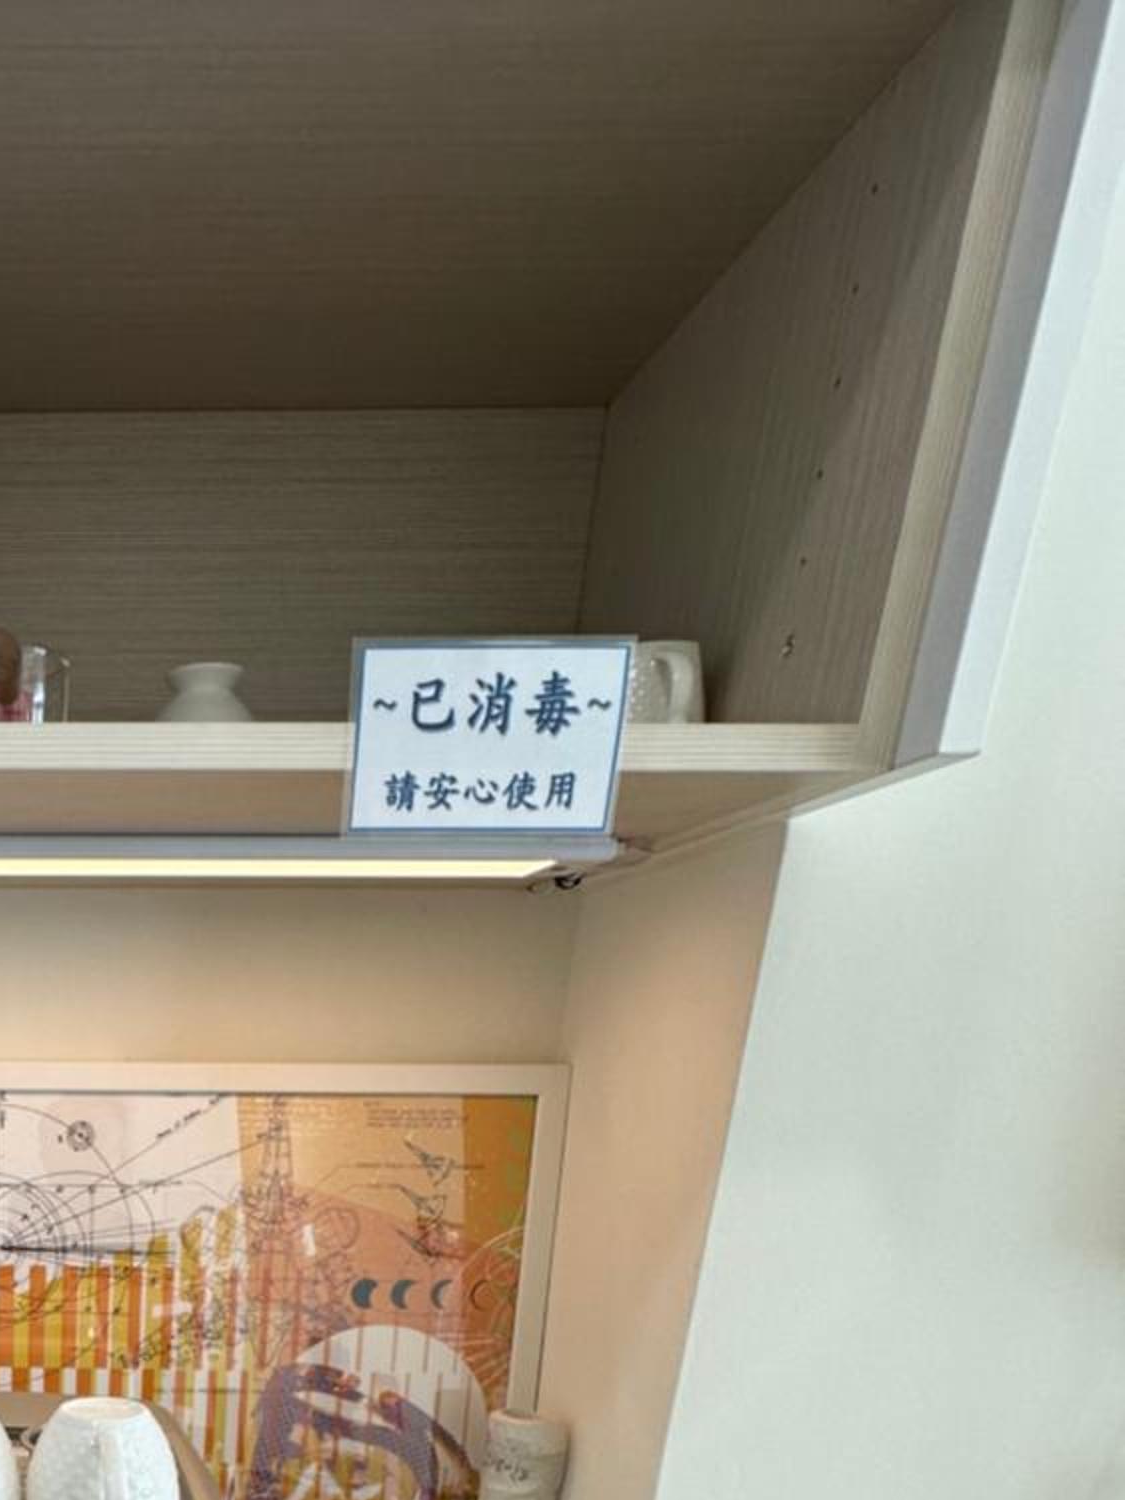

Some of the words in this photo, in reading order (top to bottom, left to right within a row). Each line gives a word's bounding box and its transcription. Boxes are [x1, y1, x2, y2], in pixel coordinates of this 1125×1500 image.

[383, 769, 577, 813] 請安心使用
